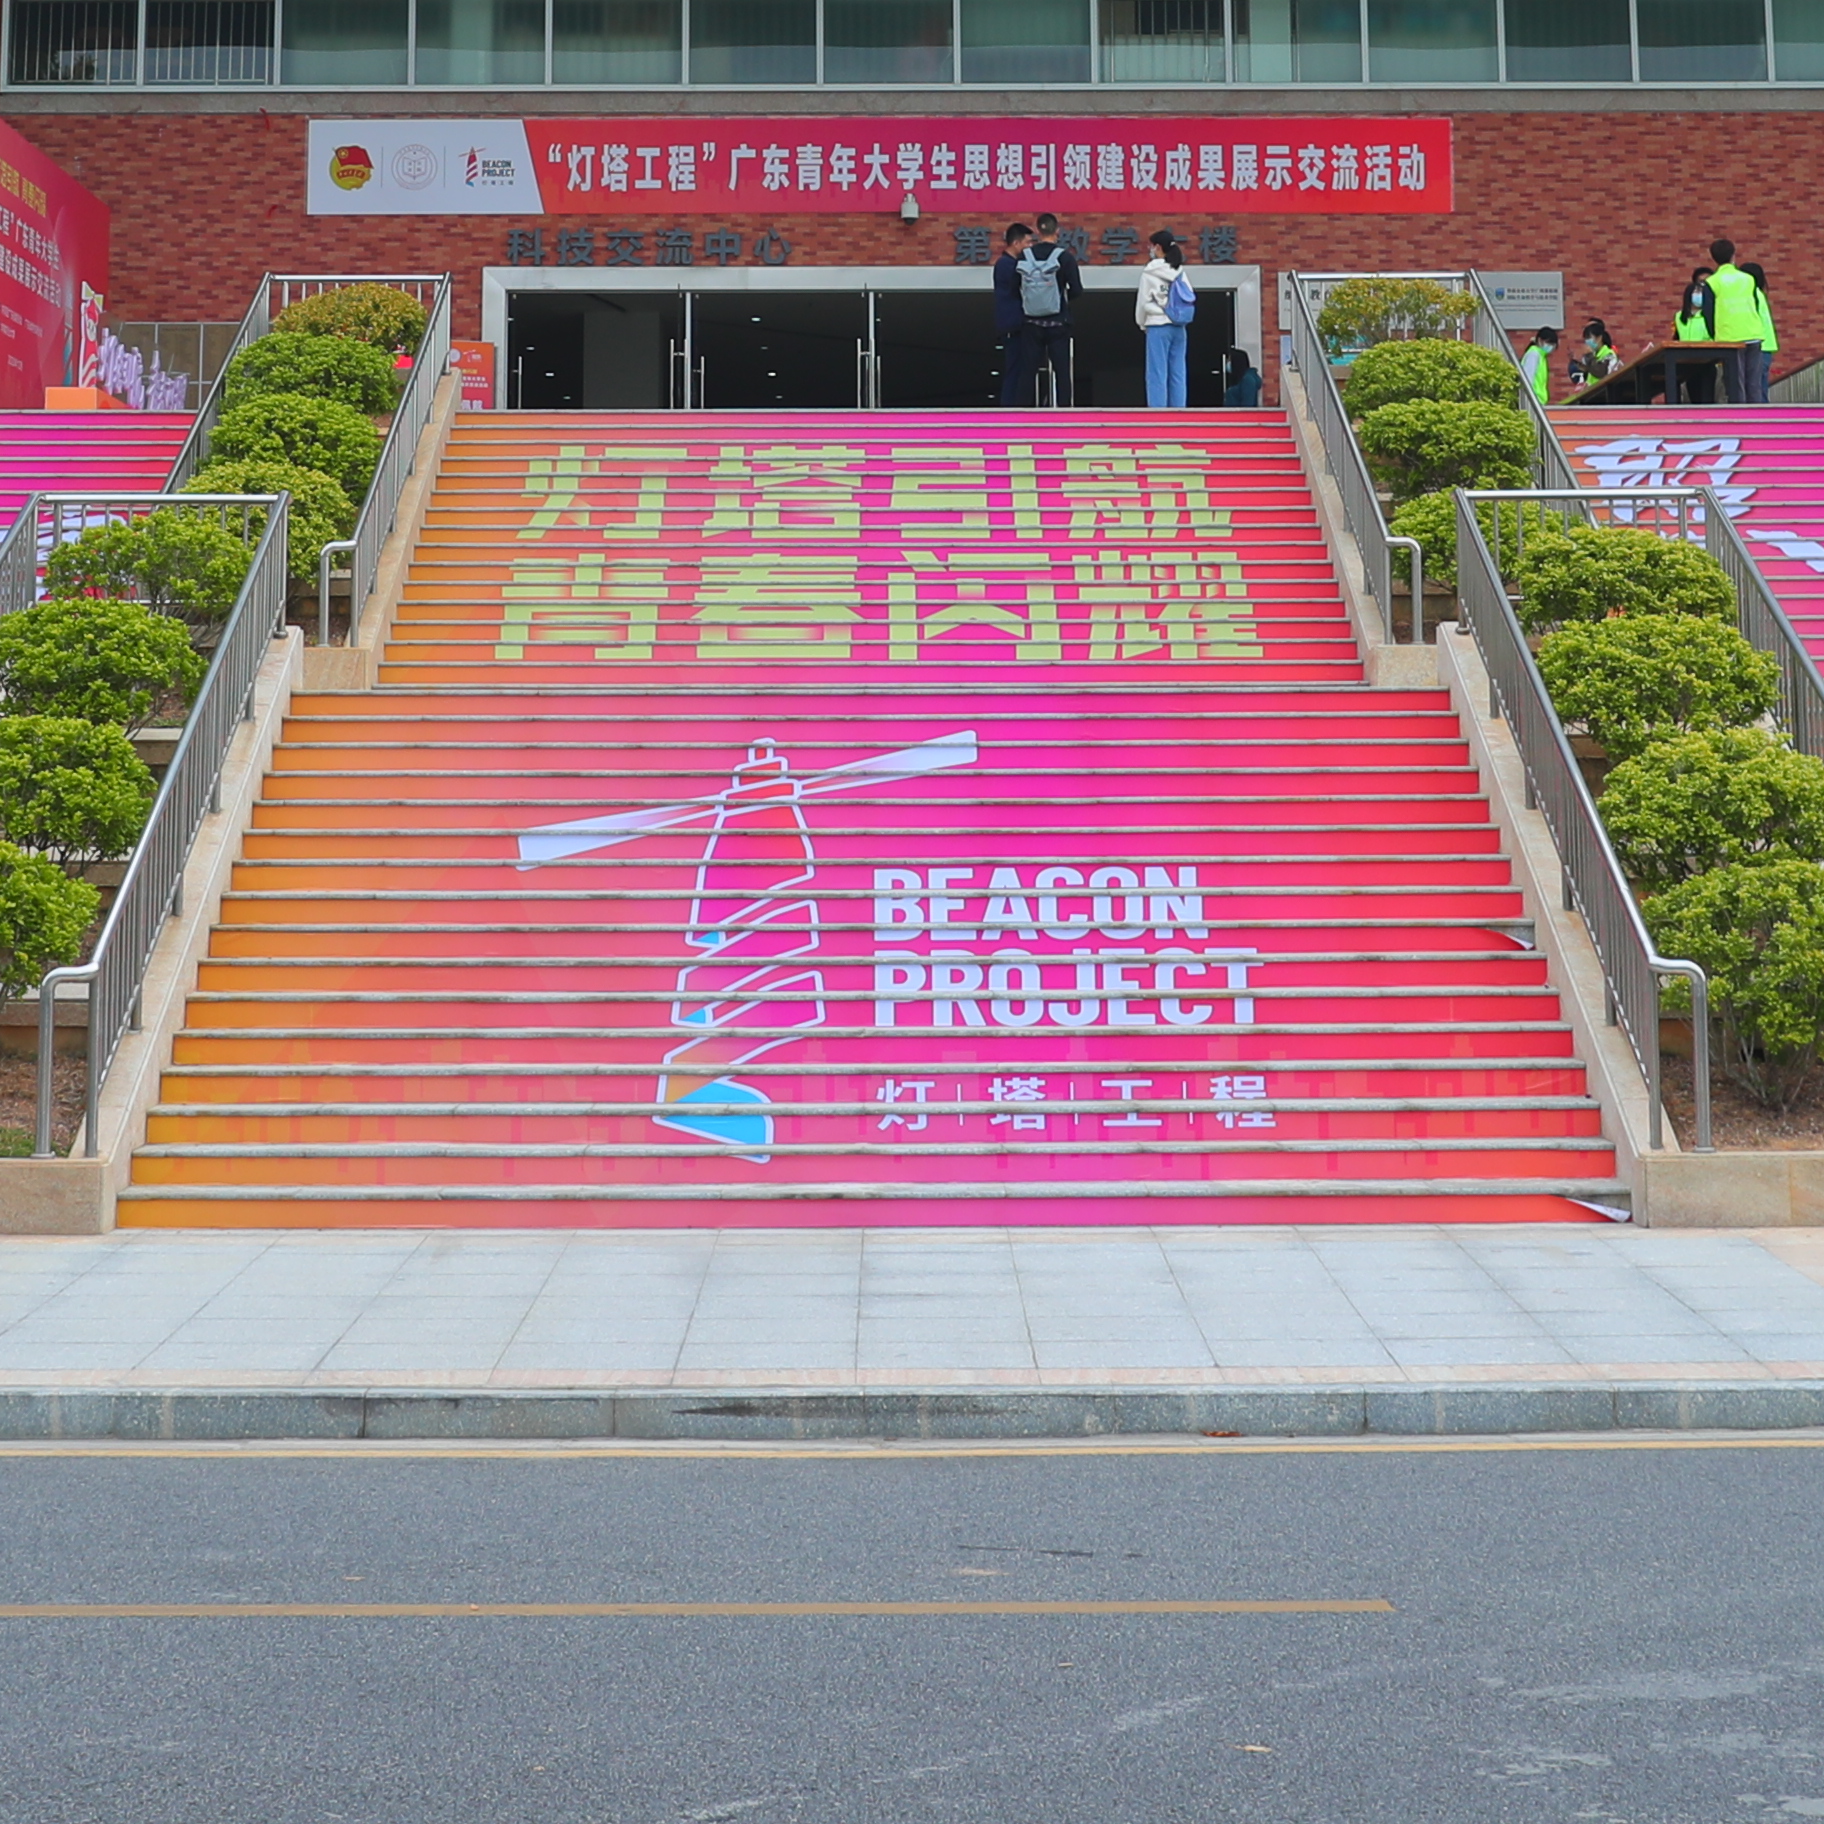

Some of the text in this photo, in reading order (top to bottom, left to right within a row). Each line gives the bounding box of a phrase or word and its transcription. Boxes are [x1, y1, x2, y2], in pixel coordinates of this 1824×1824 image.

[482, 160, 512, 168] BEACON
[482, 169, 516, 177] PROJECT
[547, 142, 1426, 192] “灯塔工程”广东青年大学生思想引领建设成果展示交流活动
[506, 227, 793, 266] 科技交流中心
[953, 225, 1239, 264] 第教学楼
[516, 443, 1234, 540] 灯塔引航
[494, 550, 1264, 660] 青春闪耀
[873, 865, 1209, 942] BEACON
[873, 947, 1265, 1027] PROJECT
